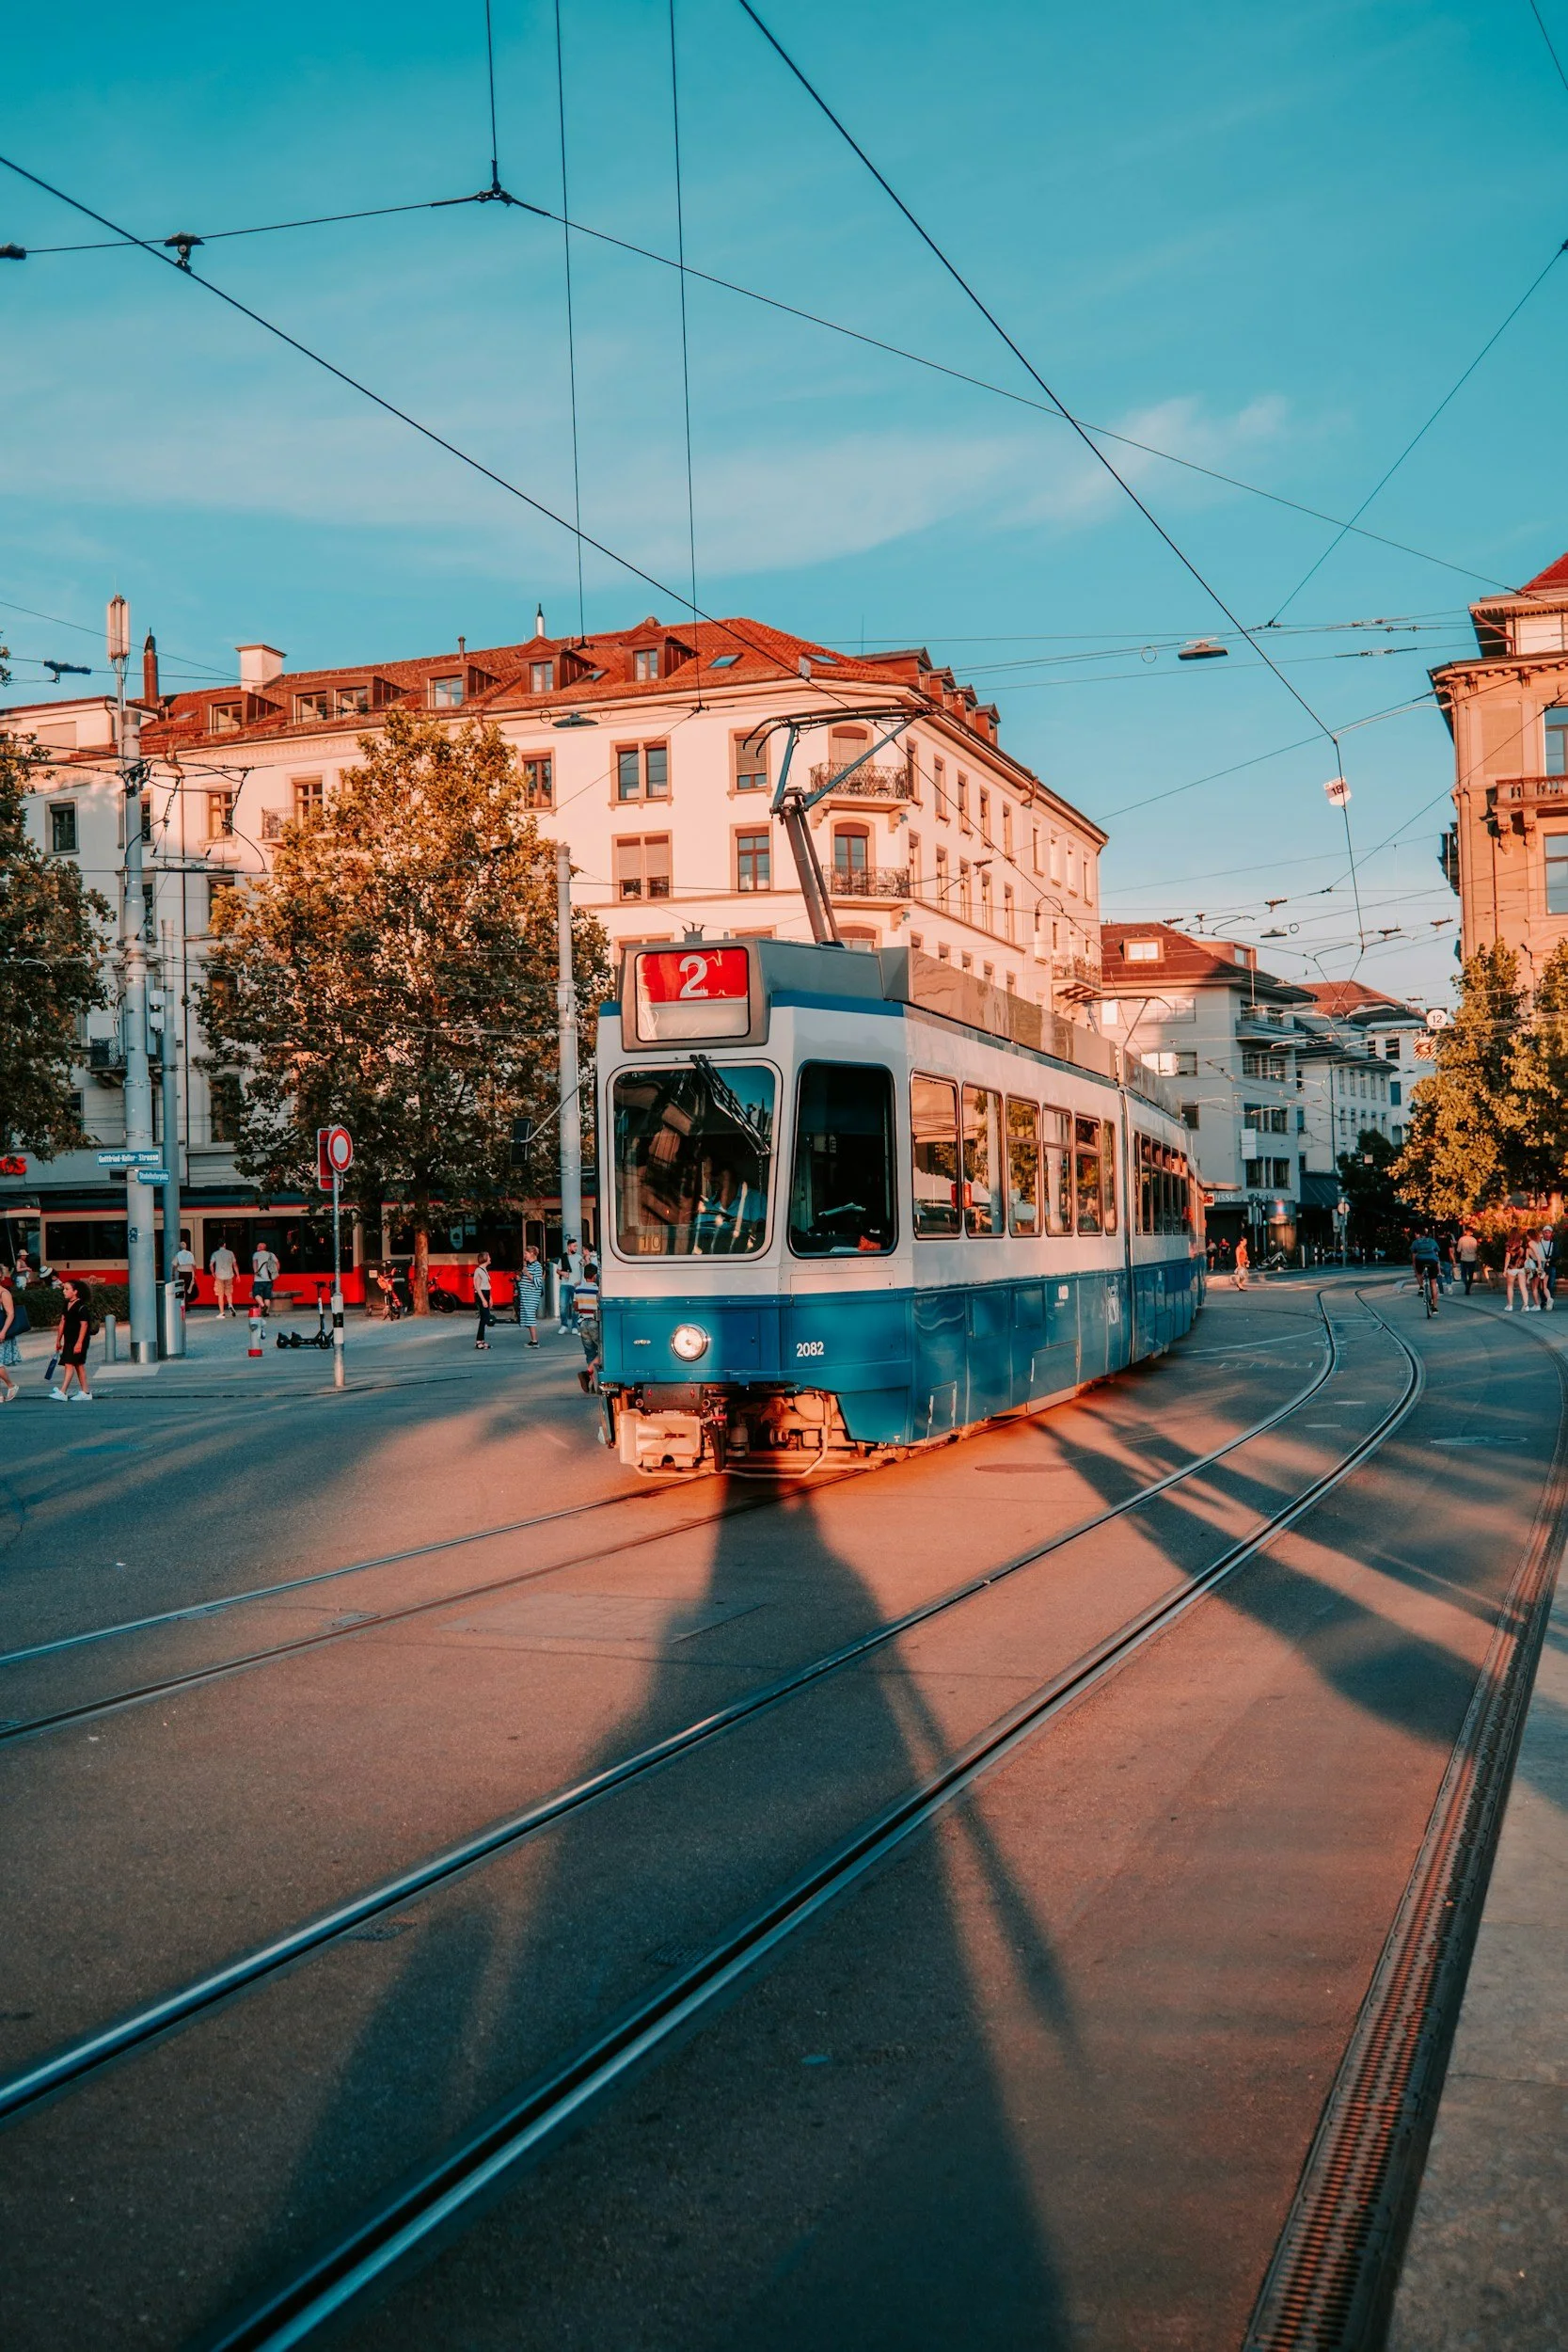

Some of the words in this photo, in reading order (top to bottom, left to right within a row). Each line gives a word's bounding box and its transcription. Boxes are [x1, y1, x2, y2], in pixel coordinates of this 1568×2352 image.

[679, 955, 708, 998] 2
[1433, 1015, 1443, 1024] 12
[797, 1342, 824, 1357] 2082
